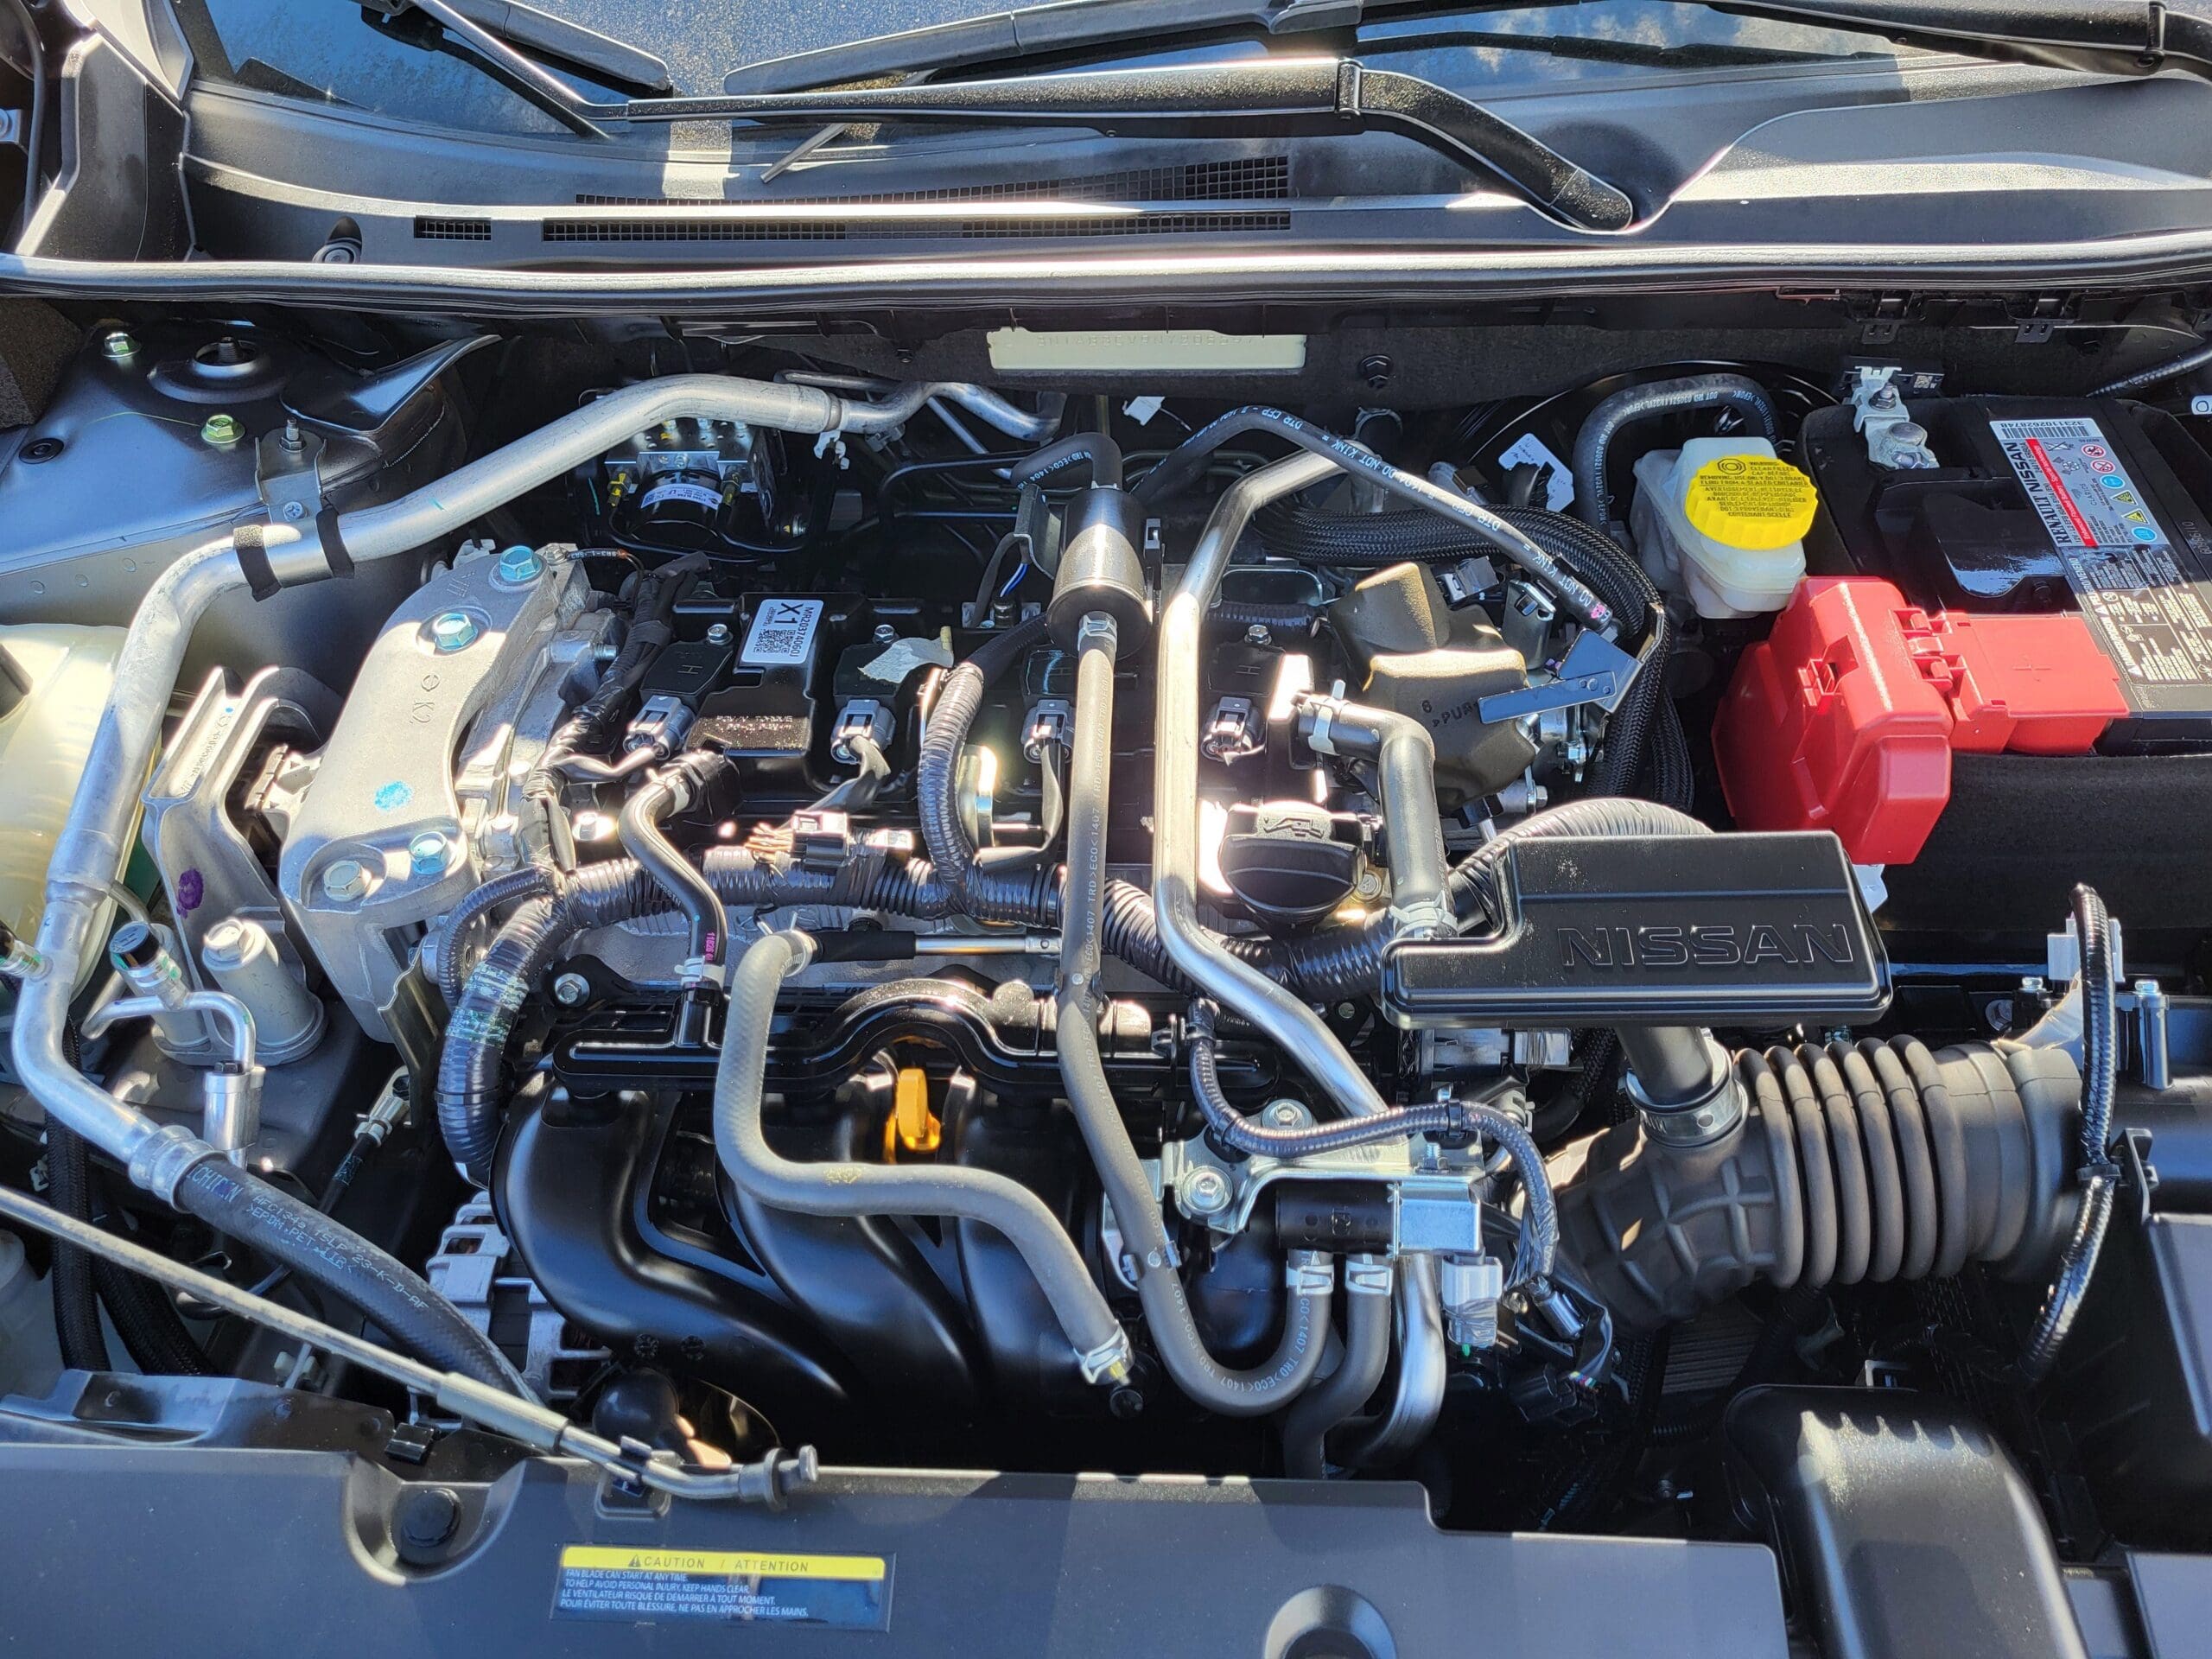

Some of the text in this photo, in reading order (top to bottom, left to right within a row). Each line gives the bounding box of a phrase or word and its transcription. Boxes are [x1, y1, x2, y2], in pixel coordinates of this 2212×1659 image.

[1331, 439, 1357, 460] KINK
[1359, 454, 1382, 470] NOT
[2003, 442, 2073, 543] RENAULT NISSAN
[774, 602, 804, 625] X1
[1558, 925, 1854, 966] NISSAN
[644, 1556, 704, 1568] CAUTION
[734, 1559, 809, 1572] ATTENTION
[567, 1569, 580, 1578] FAN
[619, 1581, 654, 1590] PERSONAL
[573, 1590, 623, 1599] VENTILATEUR
[625, 1592, 652, 1601] RISQUE
[739, 1596, 775, 1605] MOMENT.
[611, 1601, 636, 1610] TOUTE
[720, 1605, 765, 1614] APPROCHER
[781, 1608, 809, 1617] MAINS.
